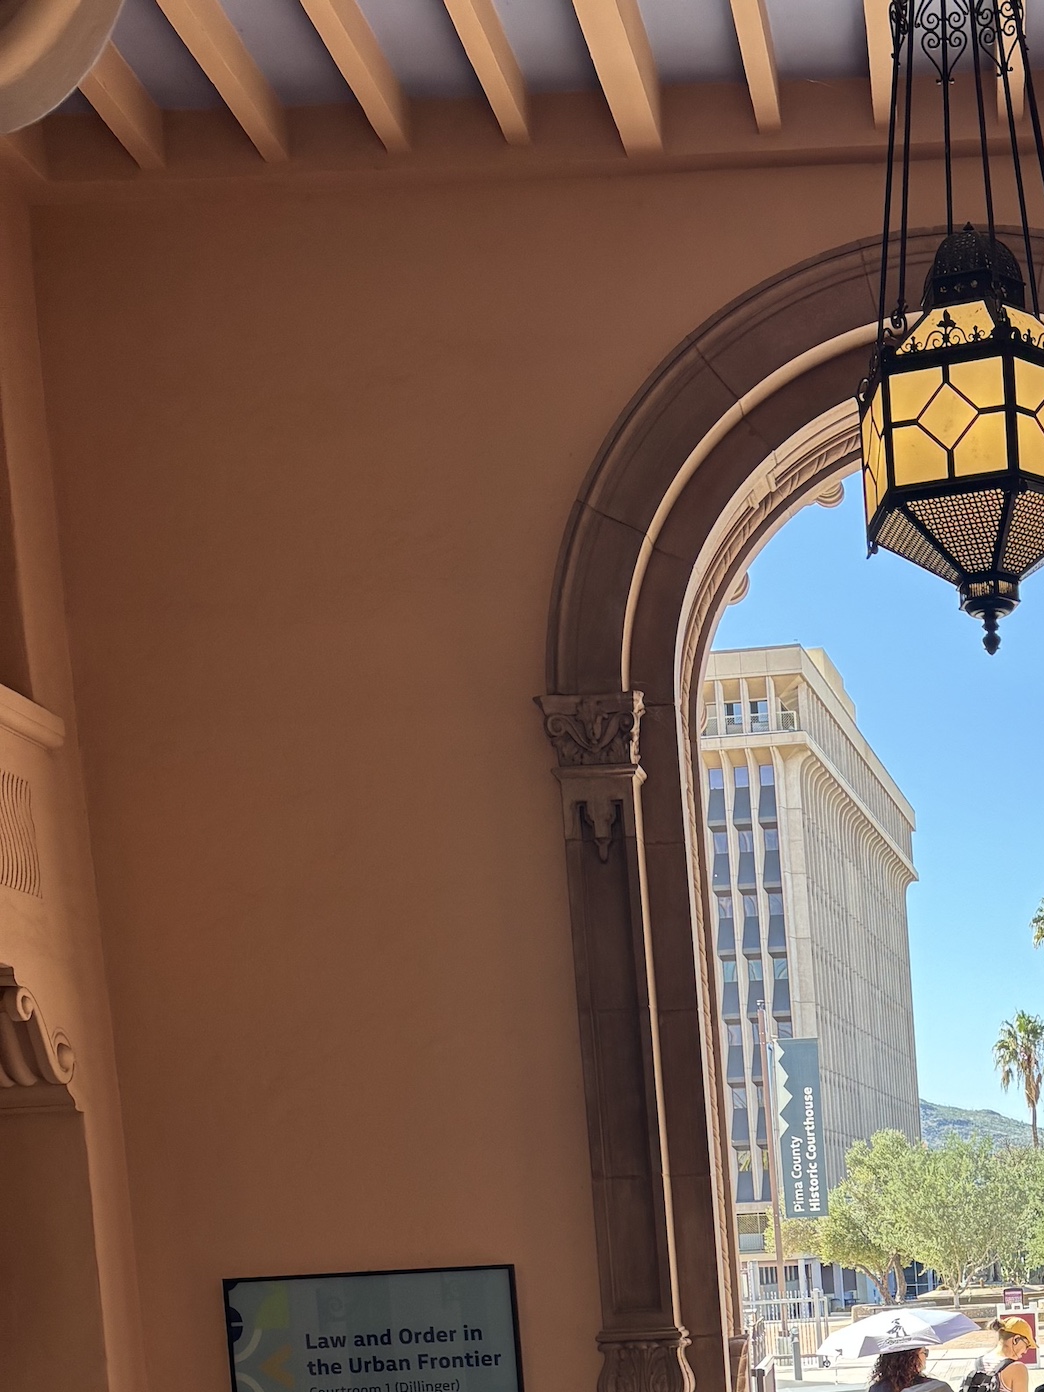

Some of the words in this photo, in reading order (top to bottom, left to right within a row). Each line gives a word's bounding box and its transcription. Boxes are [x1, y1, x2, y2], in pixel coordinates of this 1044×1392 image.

[803, 1086, 817, 1161] Courthouse
[791, 1135, 803, 1179] County
[793, 1179, 805, 1213] Pima
[806, 1162, 821, 1212] Historic
[305, 1332, 346, 1350] Law
[353, 1329, 392, 1348] and
[398, 1325, 457, 1345] Order
[463, 1324, 483, 1342] in
[307, 1359, 342, 1376] the
[349, 1355, 411, 1375] Urban
[418, 1350, 502, 1370] Frontier
